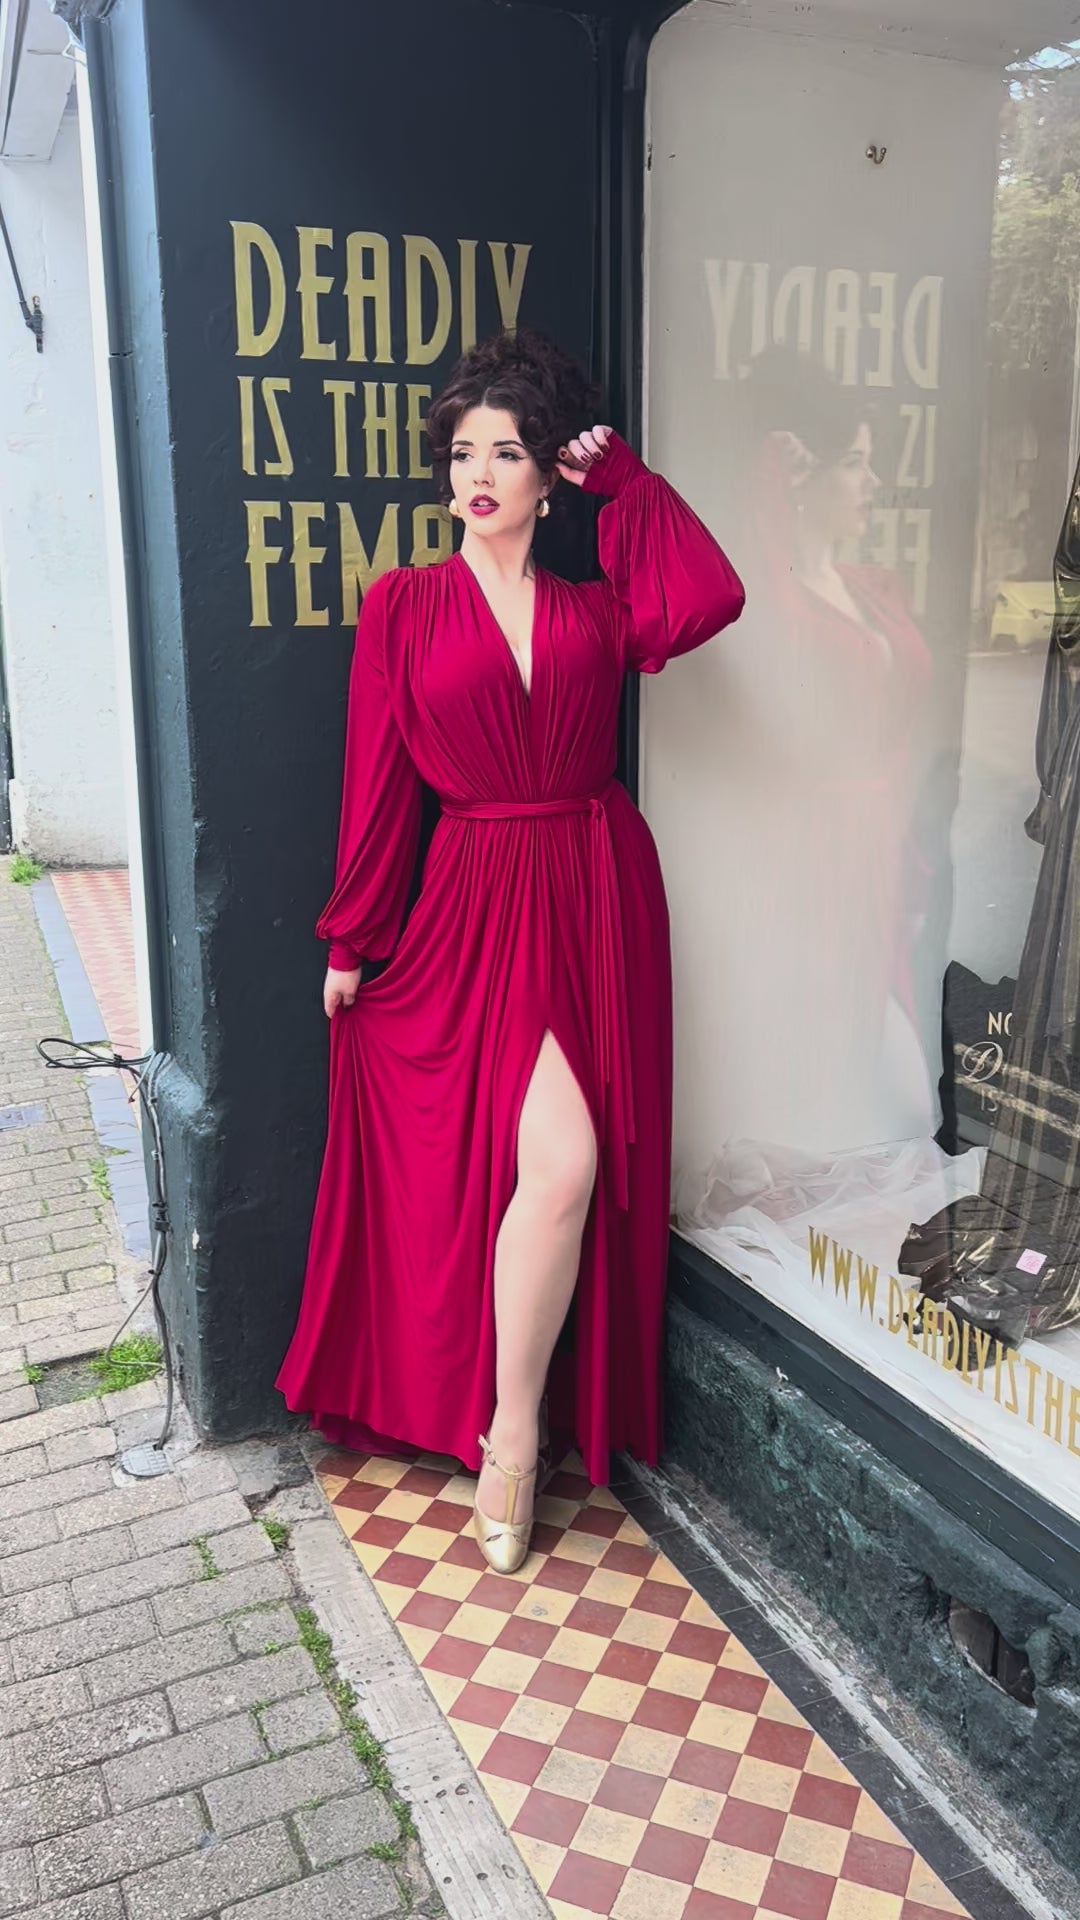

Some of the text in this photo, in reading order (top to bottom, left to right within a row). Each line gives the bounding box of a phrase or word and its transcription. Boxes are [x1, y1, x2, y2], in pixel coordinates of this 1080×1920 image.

[229, 220, 533, 365] DEADLY
[237, 375, 434, 478] IS THE
[243, 500, 454, 627] FEMA
